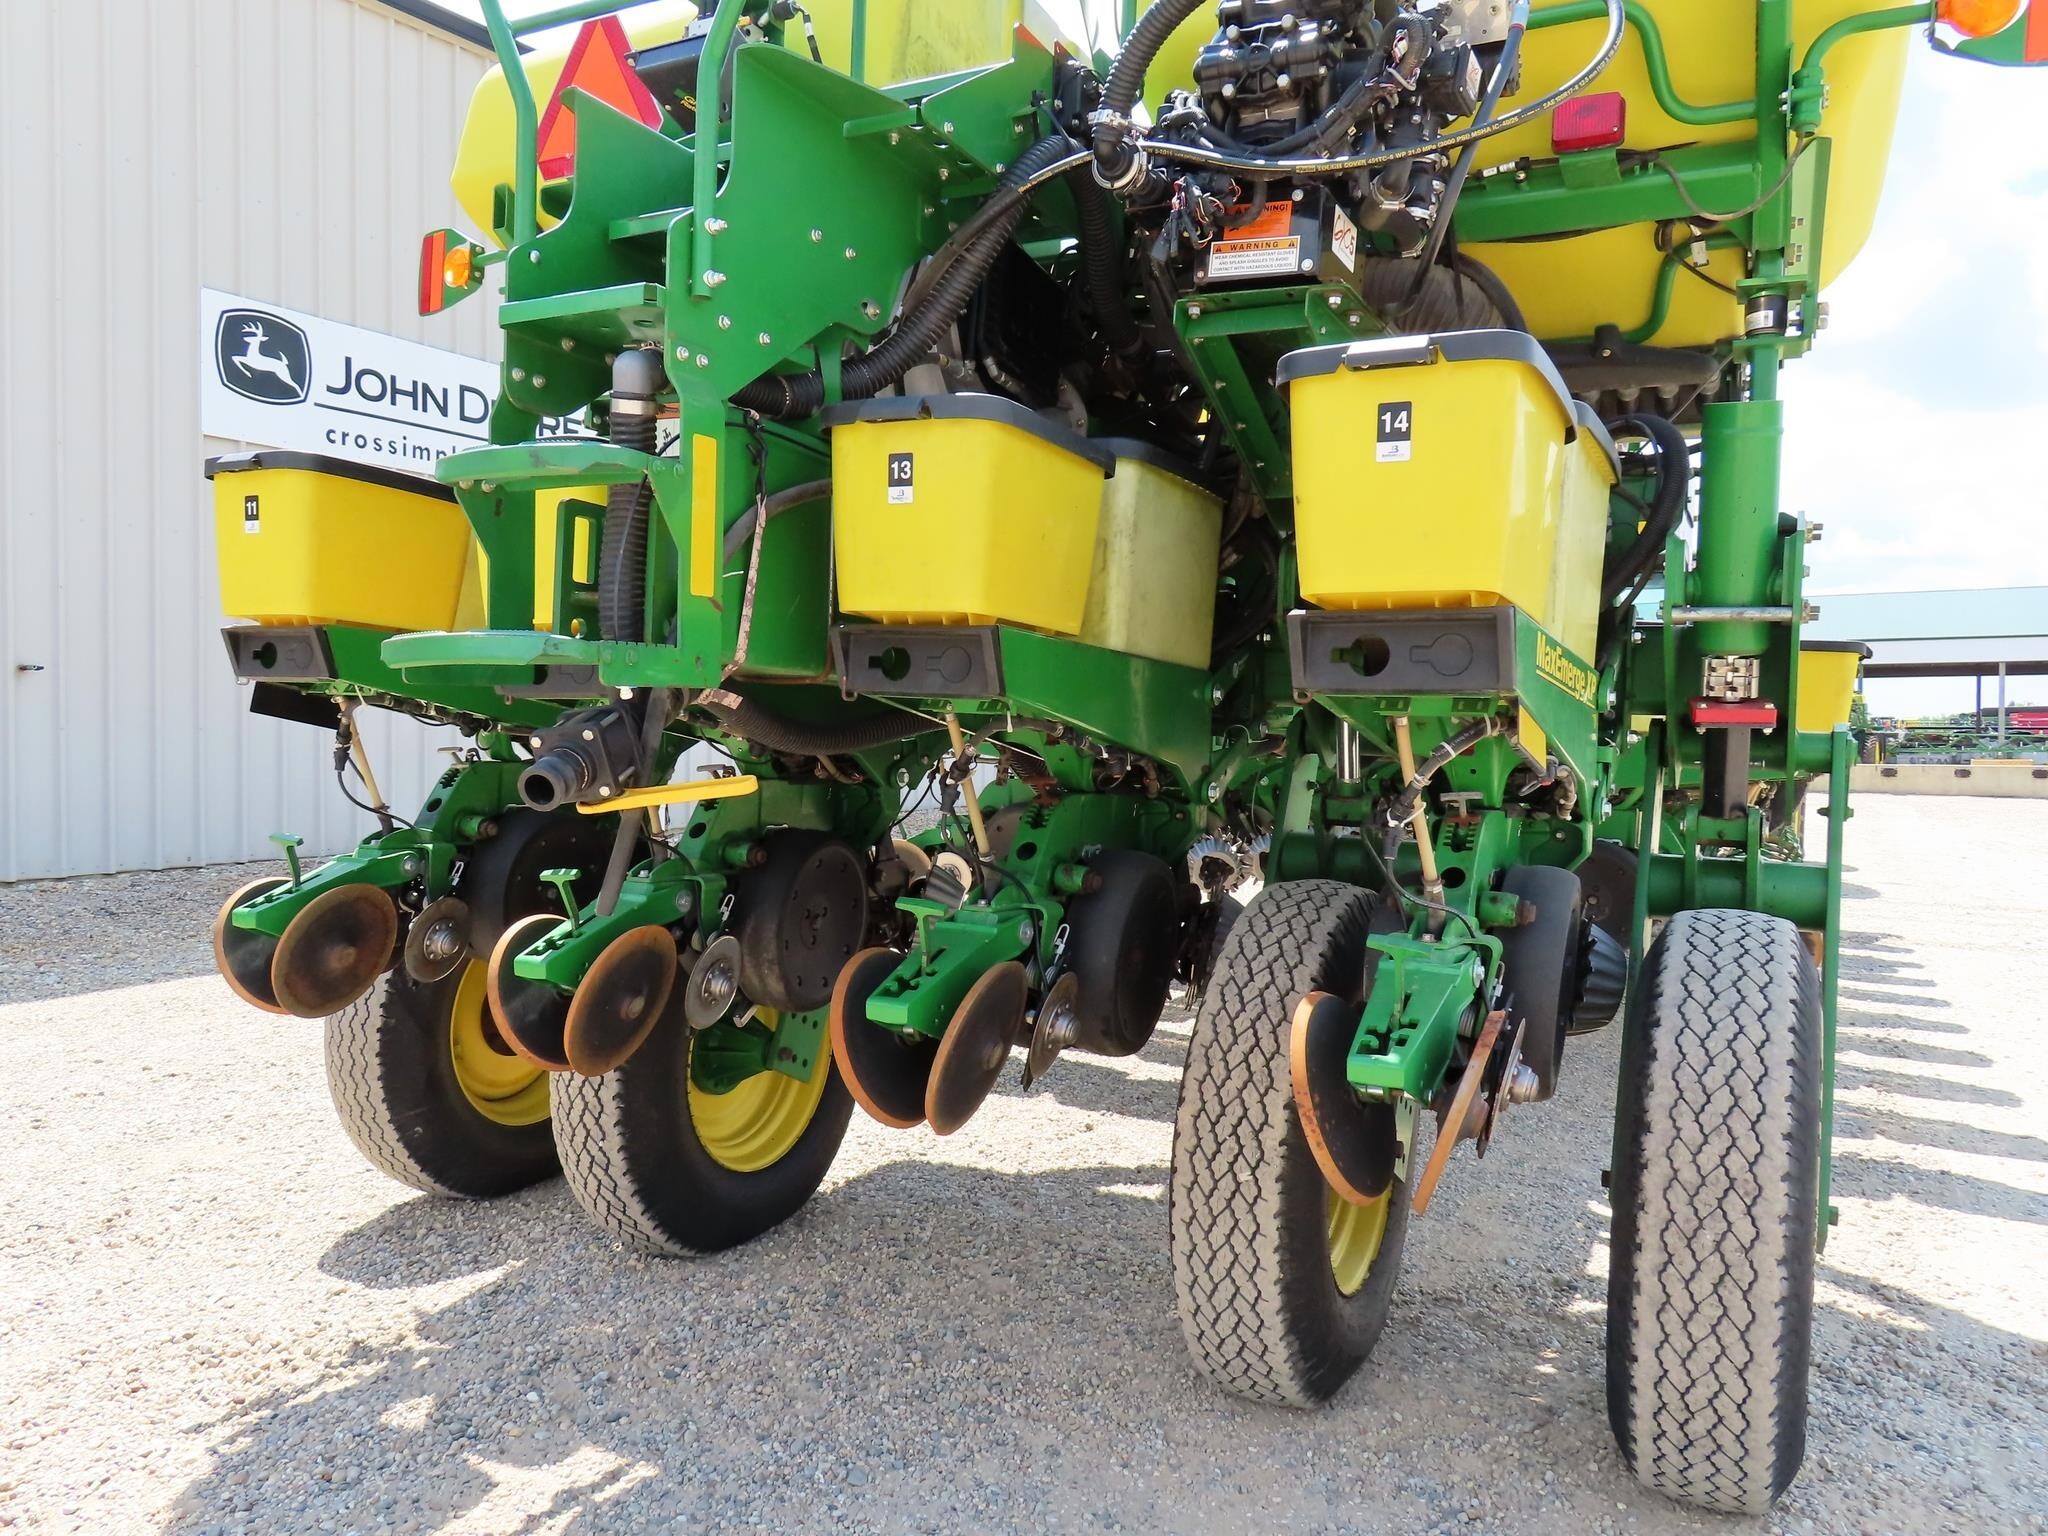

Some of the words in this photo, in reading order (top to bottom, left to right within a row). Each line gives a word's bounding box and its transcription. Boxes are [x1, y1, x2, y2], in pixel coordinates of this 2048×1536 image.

[1317, 163, 1343, 171] TOUGH
[1344, 159, 1367, 168] COVER
[1395, 151, 1407, 159] WP
[1407, 147, 1422, 156] 21.0
[1471, 126, 1492, 137] MSHA
[1543, 98, 1556, 109] SAE
[1230, 241, 1279, 251] WARNING
[326, 356, 449, 418] JOHN
[1381, 410, 1409, 433] 14
[891, 460, 912, 480] 13
[246, 501, 257, 515] 11
[1536, 631, 1586, 700] MaxEmerge
